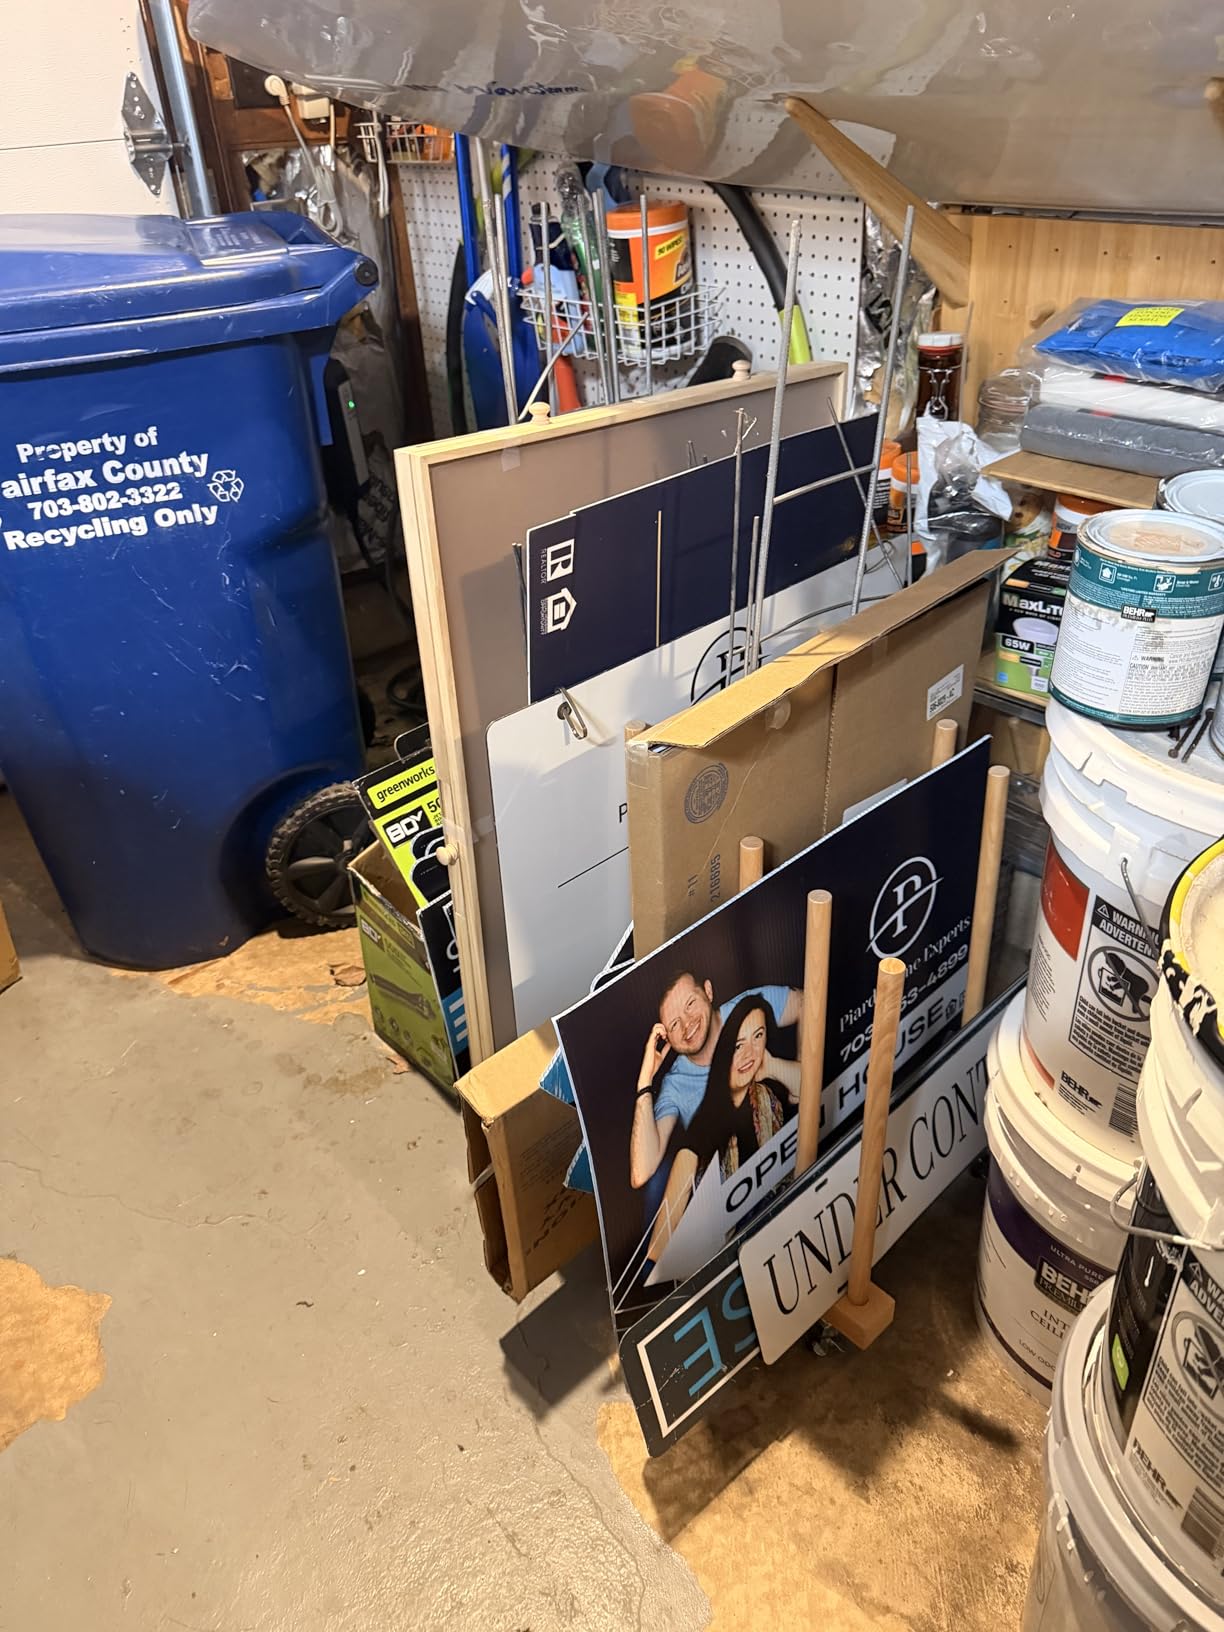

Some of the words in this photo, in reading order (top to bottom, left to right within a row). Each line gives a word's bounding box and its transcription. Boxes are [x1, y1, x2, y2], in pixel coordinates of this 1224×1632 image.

[16, 432, 127, 464] Property
[134, 426, 158, 448] of
[0, 468, 98, 499] airfax
[102, 450, 209, 484] County
[27, 482, 183, 520] 703-802-3322
[3, 515, 148, 551] Recycling
[153, 503, 218, 528] Only
[1123, 605, 1146, 617] BEHR
[1004, 637, 1031, 651] 65W
[376, 766, 436, 803] greenworks
[1100, 919, 1155, 958] ADVERTEN
[839, 988, 877, 1032] Piard
[924, 916, 971, 962] Experts
[1060, 1070, 1090, 1100] BEHR
[725, 1103, 827, 1213] OPE
[763, 1147, 907, 1316] UNDR
[1050, 1244, 1076, 1266] ULTRA
[1078, 1263, 1105, 1281] PURE
[1041, 1261, 1092, 1306] BEH
